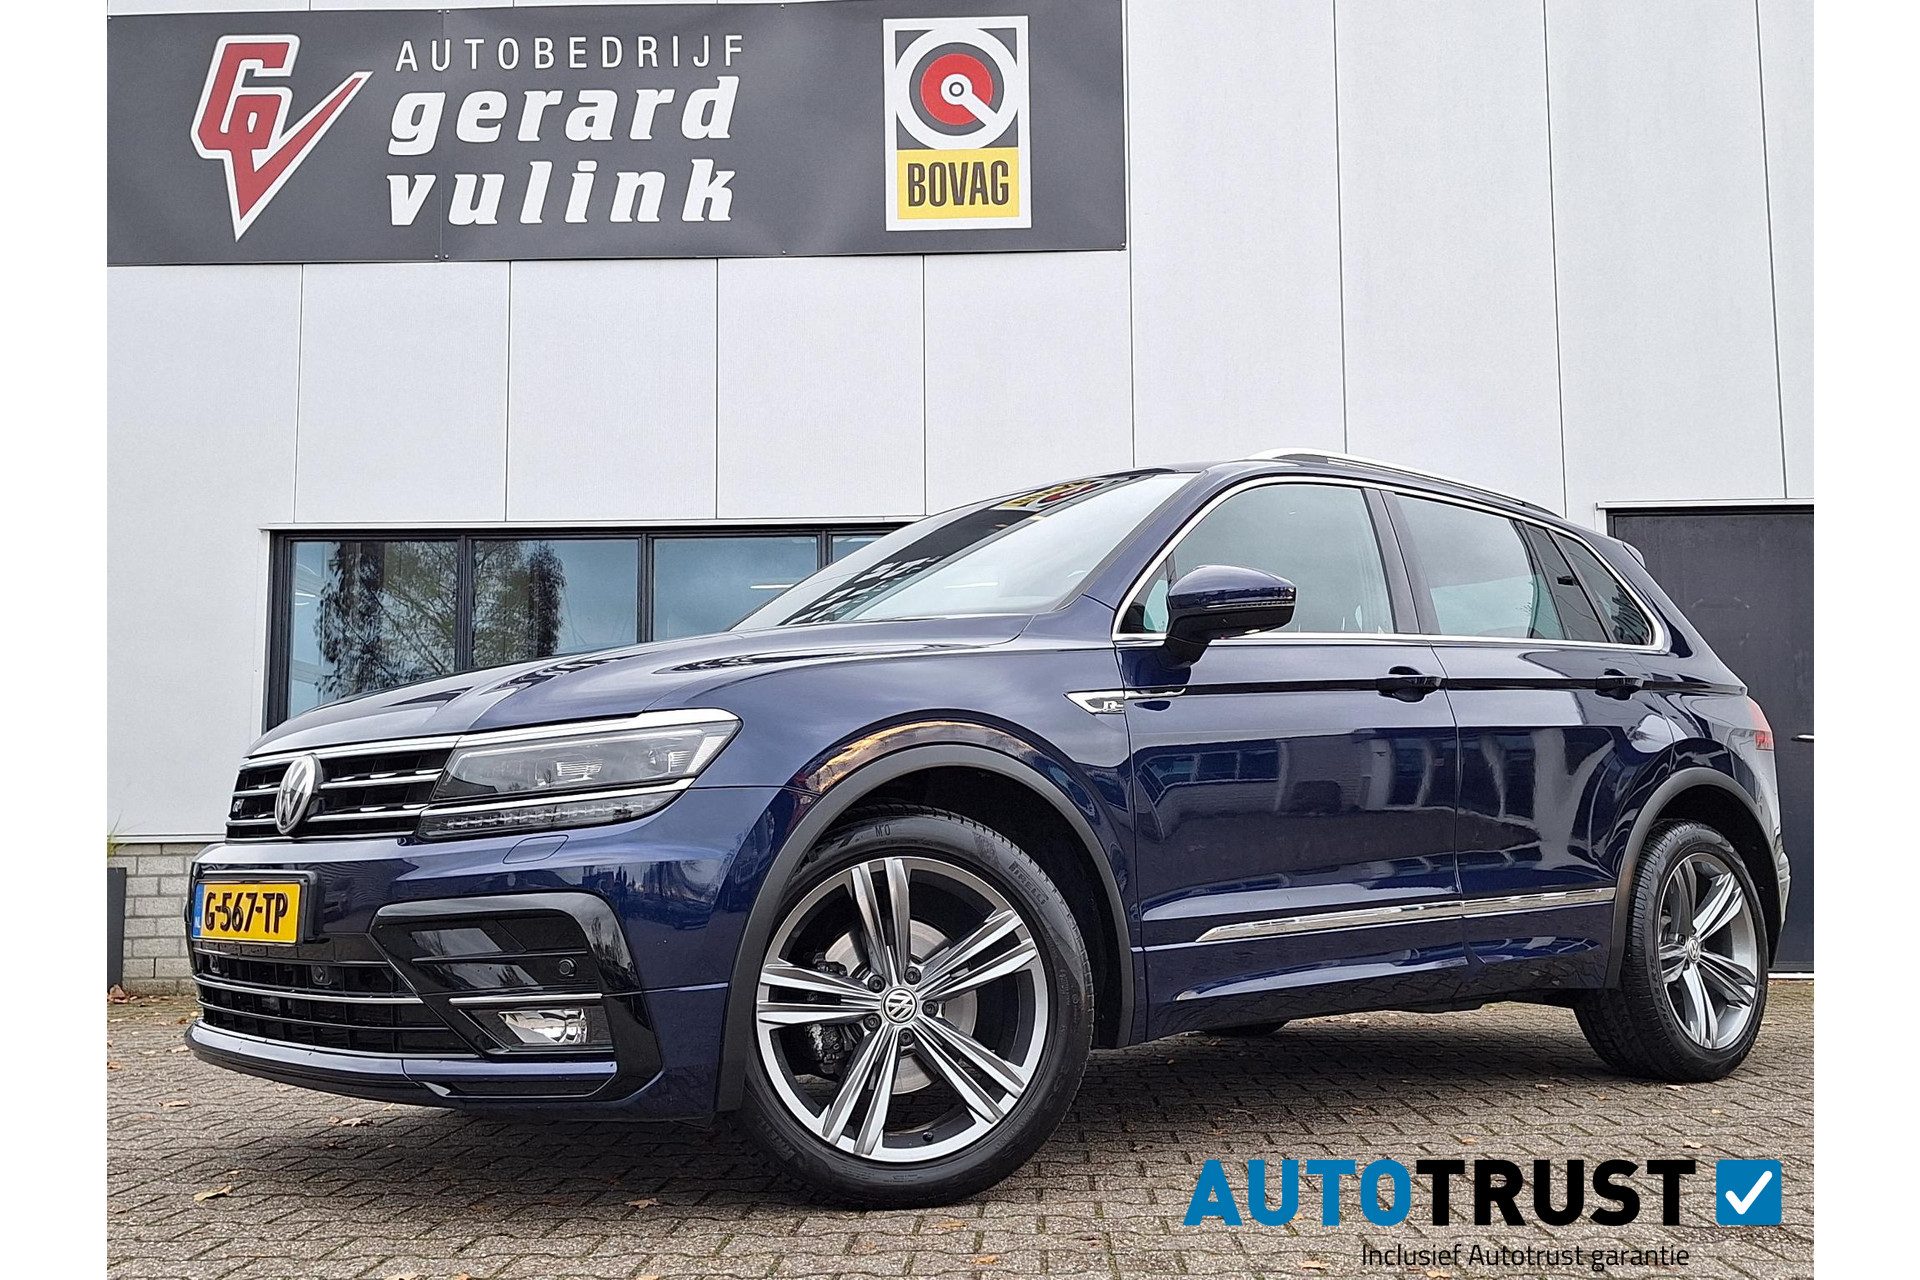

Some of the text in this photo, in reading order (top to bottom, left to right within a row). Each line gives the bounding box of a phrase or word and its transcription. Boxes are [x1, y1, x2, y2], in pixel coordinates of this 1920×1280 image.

[395, 35, 744, 72] AUTOBEDRIJF
[388, 75, 740, 156] gerard
[386, 158, 736, 227] vulink
[907, 160, 1010, 207] BOVAG
[204, 891, 289, 934] G-567-TP
